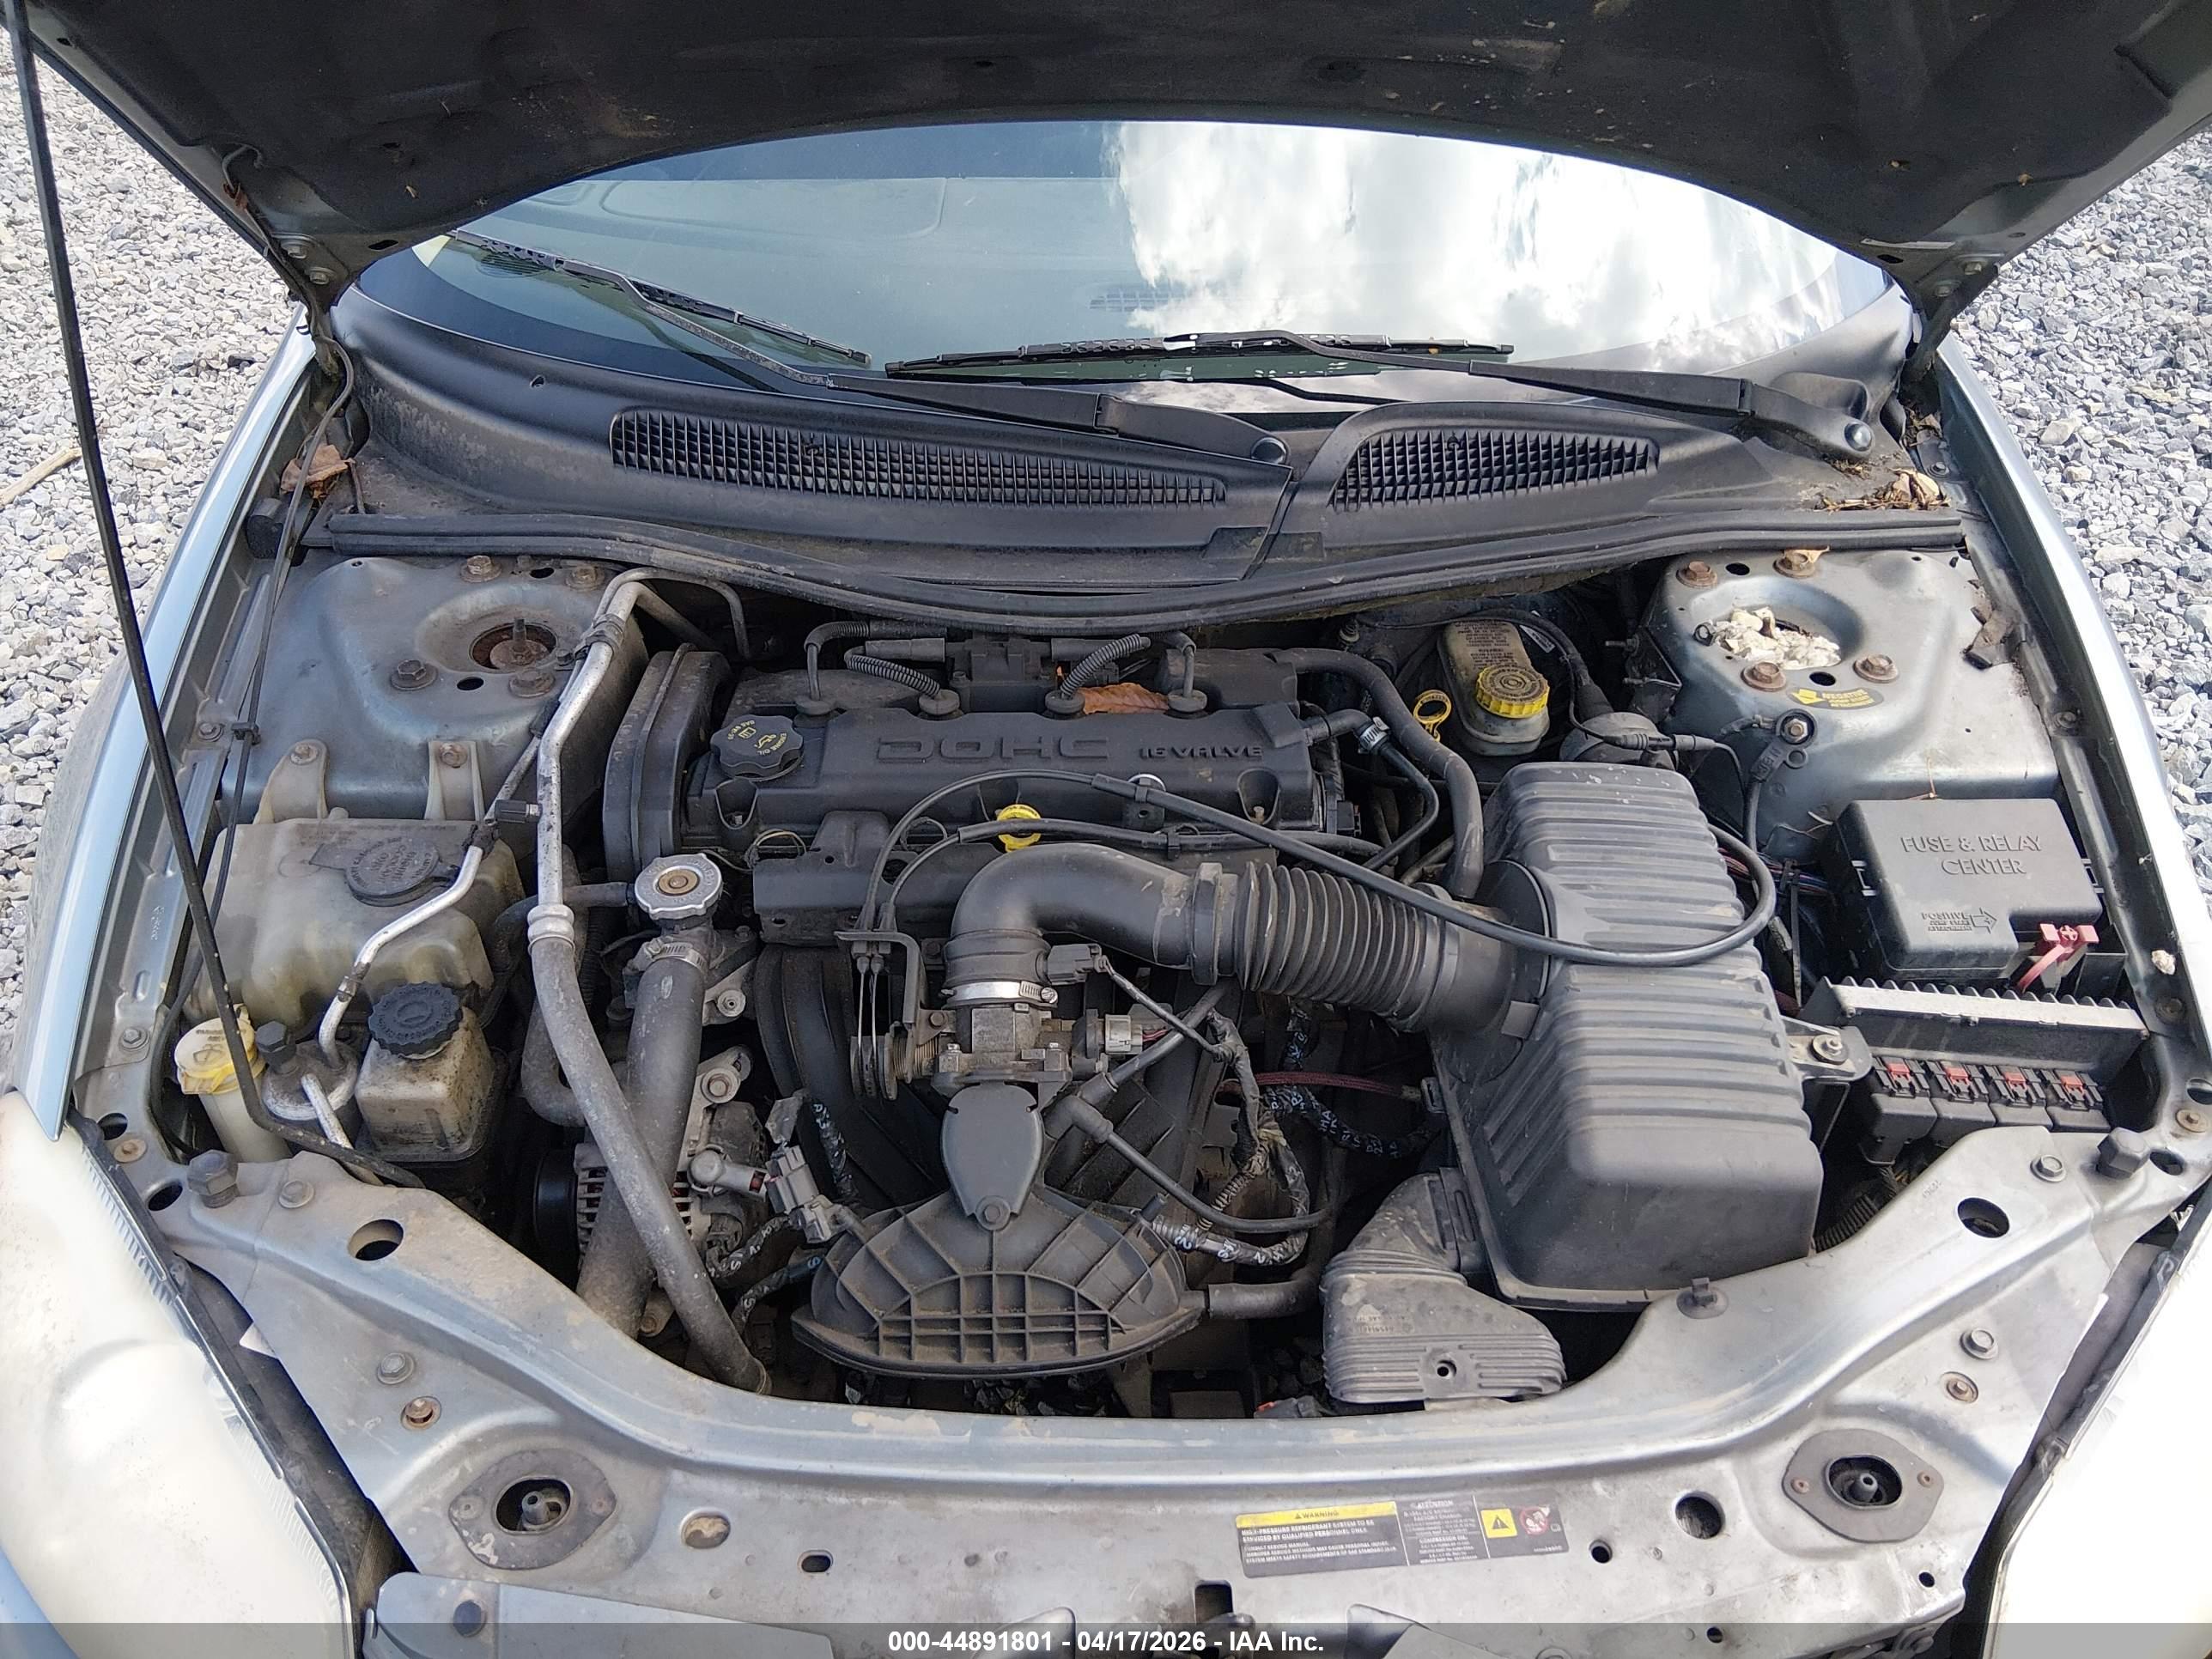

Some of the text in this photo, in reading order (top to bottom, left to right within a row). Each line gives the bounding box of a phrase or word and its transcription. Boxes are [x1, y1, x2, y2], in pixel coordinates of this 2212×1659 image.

[770, 732, 787, 750] ENGINE
[876, 734, 1109, 763] DOHC
[1900, 835, 2042, 852] FUSE & RELAY
[1941, 858, 2027, 875] CENTER
[1281, 1531, 1314, 1540] QUALIFIED
